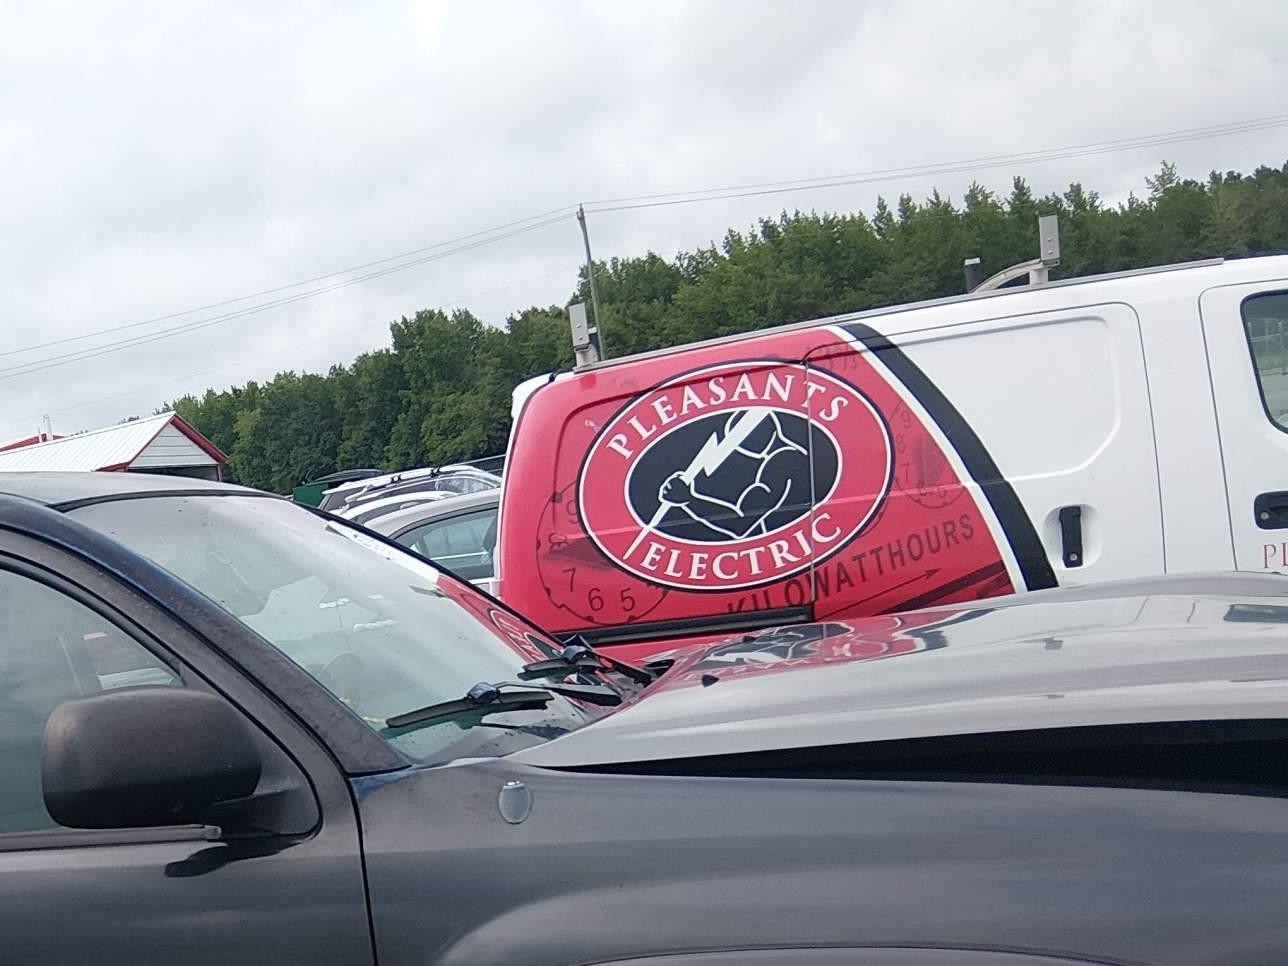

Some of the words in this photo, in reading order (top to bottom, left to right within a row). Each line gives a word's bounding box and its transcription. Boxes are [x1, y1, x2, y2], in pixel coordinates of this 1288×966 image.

[607, 372, 848, 460] PLEASANTS
[640, 513, 842, 582] ELECTRIC
[562, 567, 576, 592] 7
[588, 588, 604, 612] 6
[620, 588, 635, 612] 5
